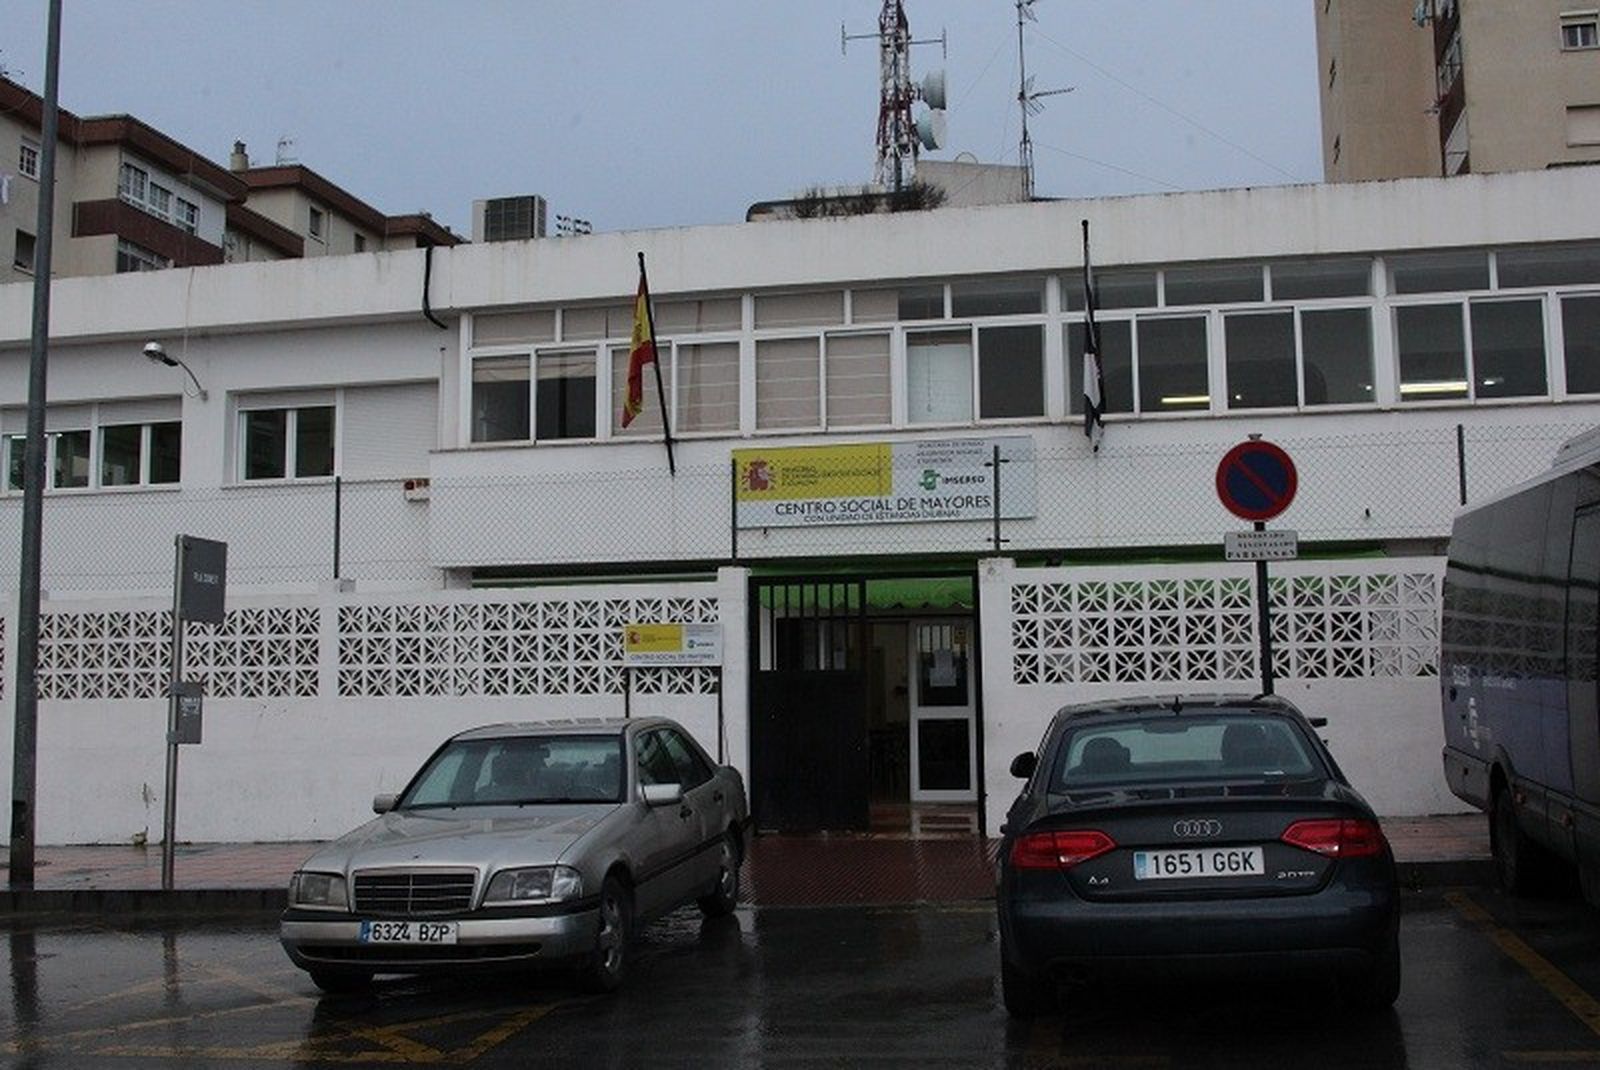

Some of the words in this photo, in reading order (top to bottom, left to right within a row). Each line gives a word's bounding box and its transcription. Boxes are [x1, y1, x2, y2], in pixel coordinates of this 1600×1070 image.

[775, 500, 837, 515] CENTRO
[840, 498, 893, 513] SOCIAL
[897, 497, 917, 510] DE
[920, 495, 991, 509] MAYORES
[804, 514, 824, 522] CON
[1152, 853, 1205, 875] 1651
[1213, 851, 1256, 872] GGK
[372, 923, 411, 941] 6324
[418, 923, 450, 941] BZP
